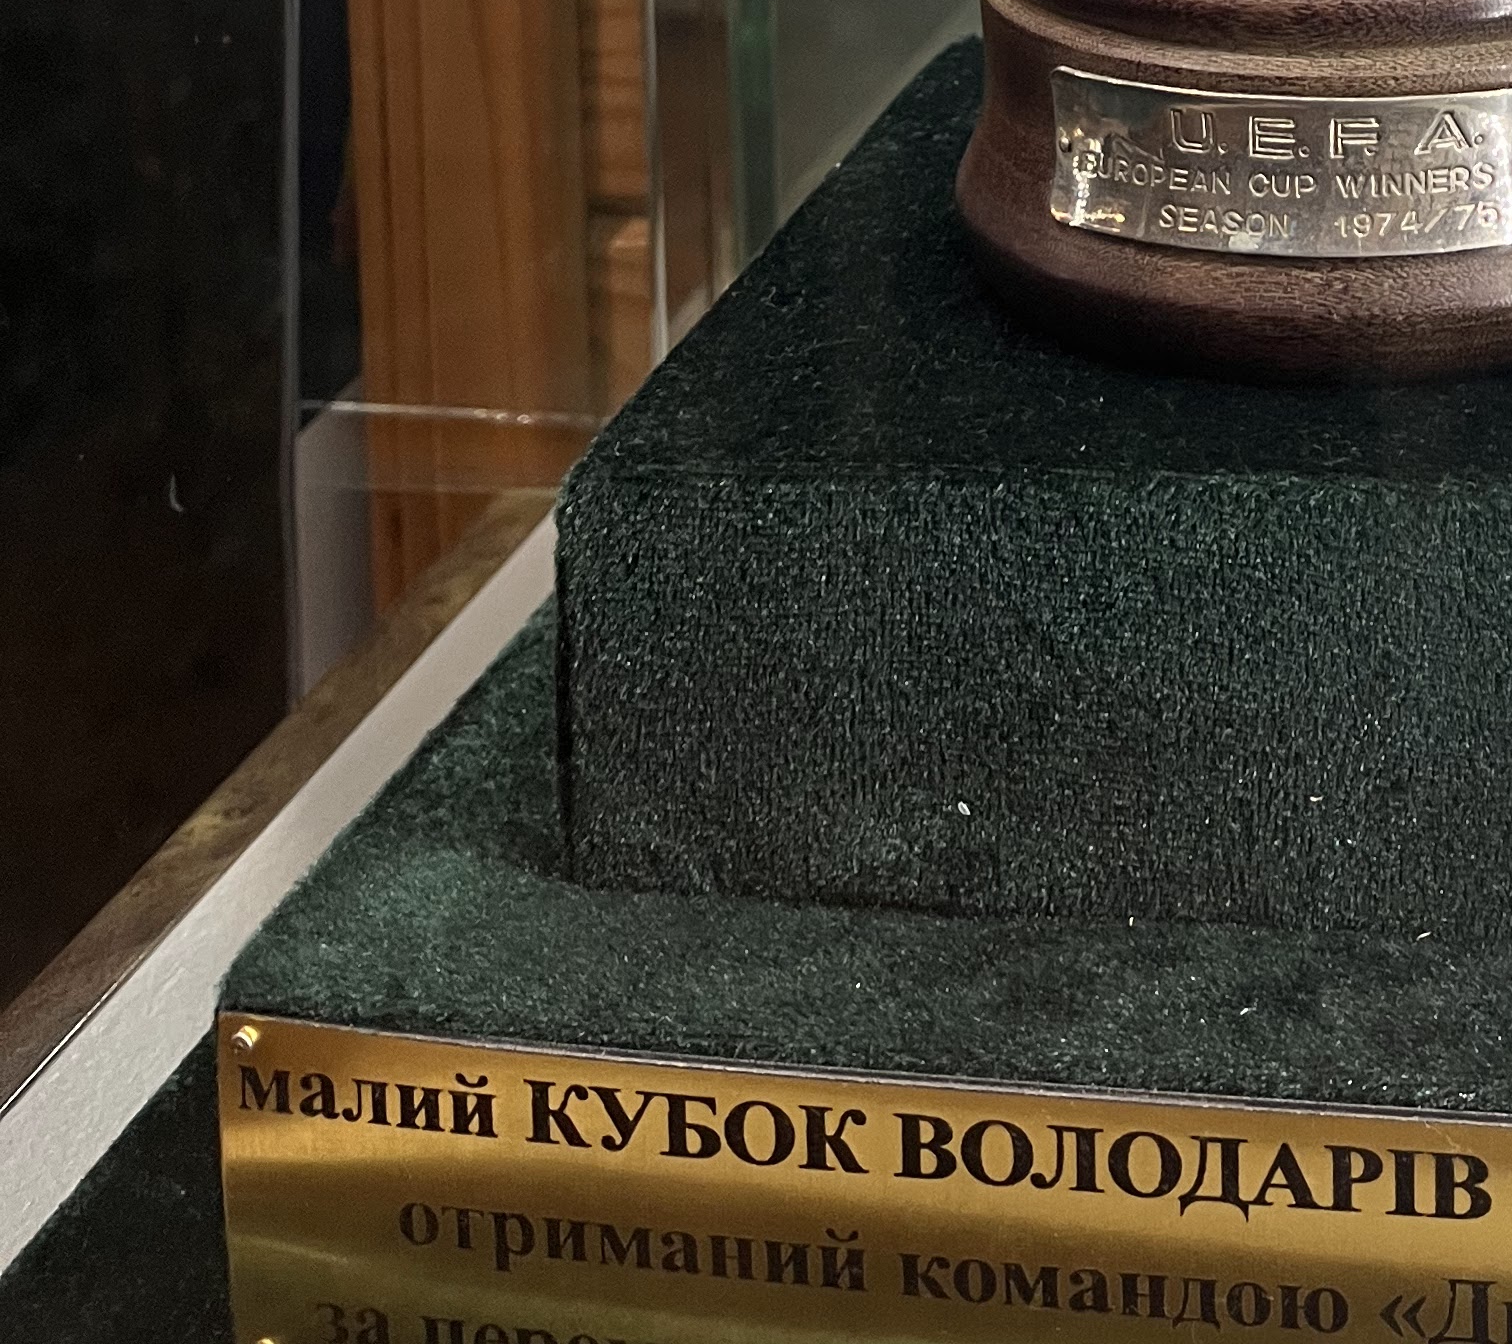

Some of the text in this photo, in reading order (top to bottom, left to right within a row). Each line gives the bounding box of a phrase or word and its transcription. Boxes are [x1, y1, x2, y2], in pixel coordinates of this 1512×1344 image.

[1159, 200, 1501, 239] SEASON 1974/75
[1248, 171, 1317, 199] CUP
[238, 1064, 499, 1139] малий
[523, 1078, 869, 1177] КУБОК
[893, 1111, 1494, 1223] ВОЛОДАРІВ
[399, 1200, 867, 1292] отриманий
[897, 1252, 1350, 1334] командою
